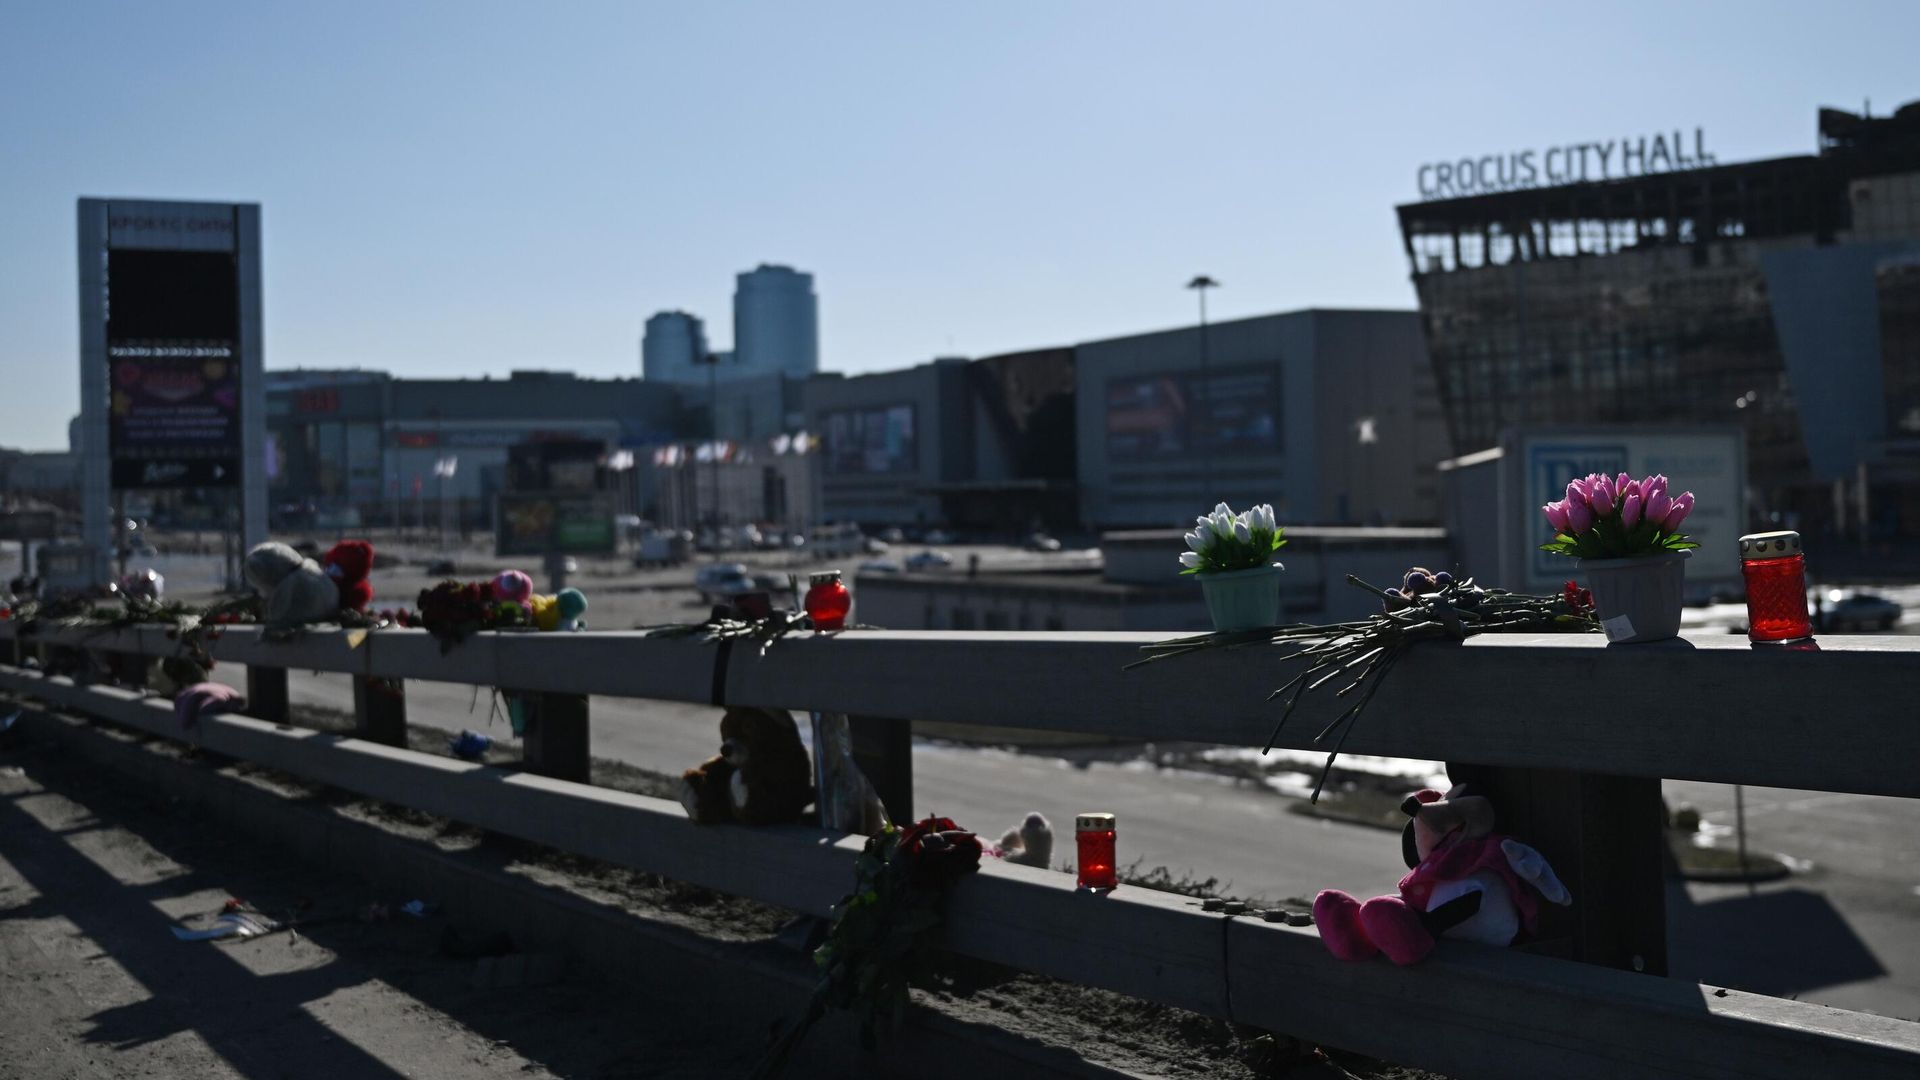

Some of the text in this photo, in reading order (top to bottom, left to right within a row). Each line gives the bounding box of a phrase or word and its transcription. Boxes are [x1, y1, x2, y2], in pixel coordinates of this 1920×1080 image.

[1417, 127, 1716, 196] CROCUS CITY HALL
